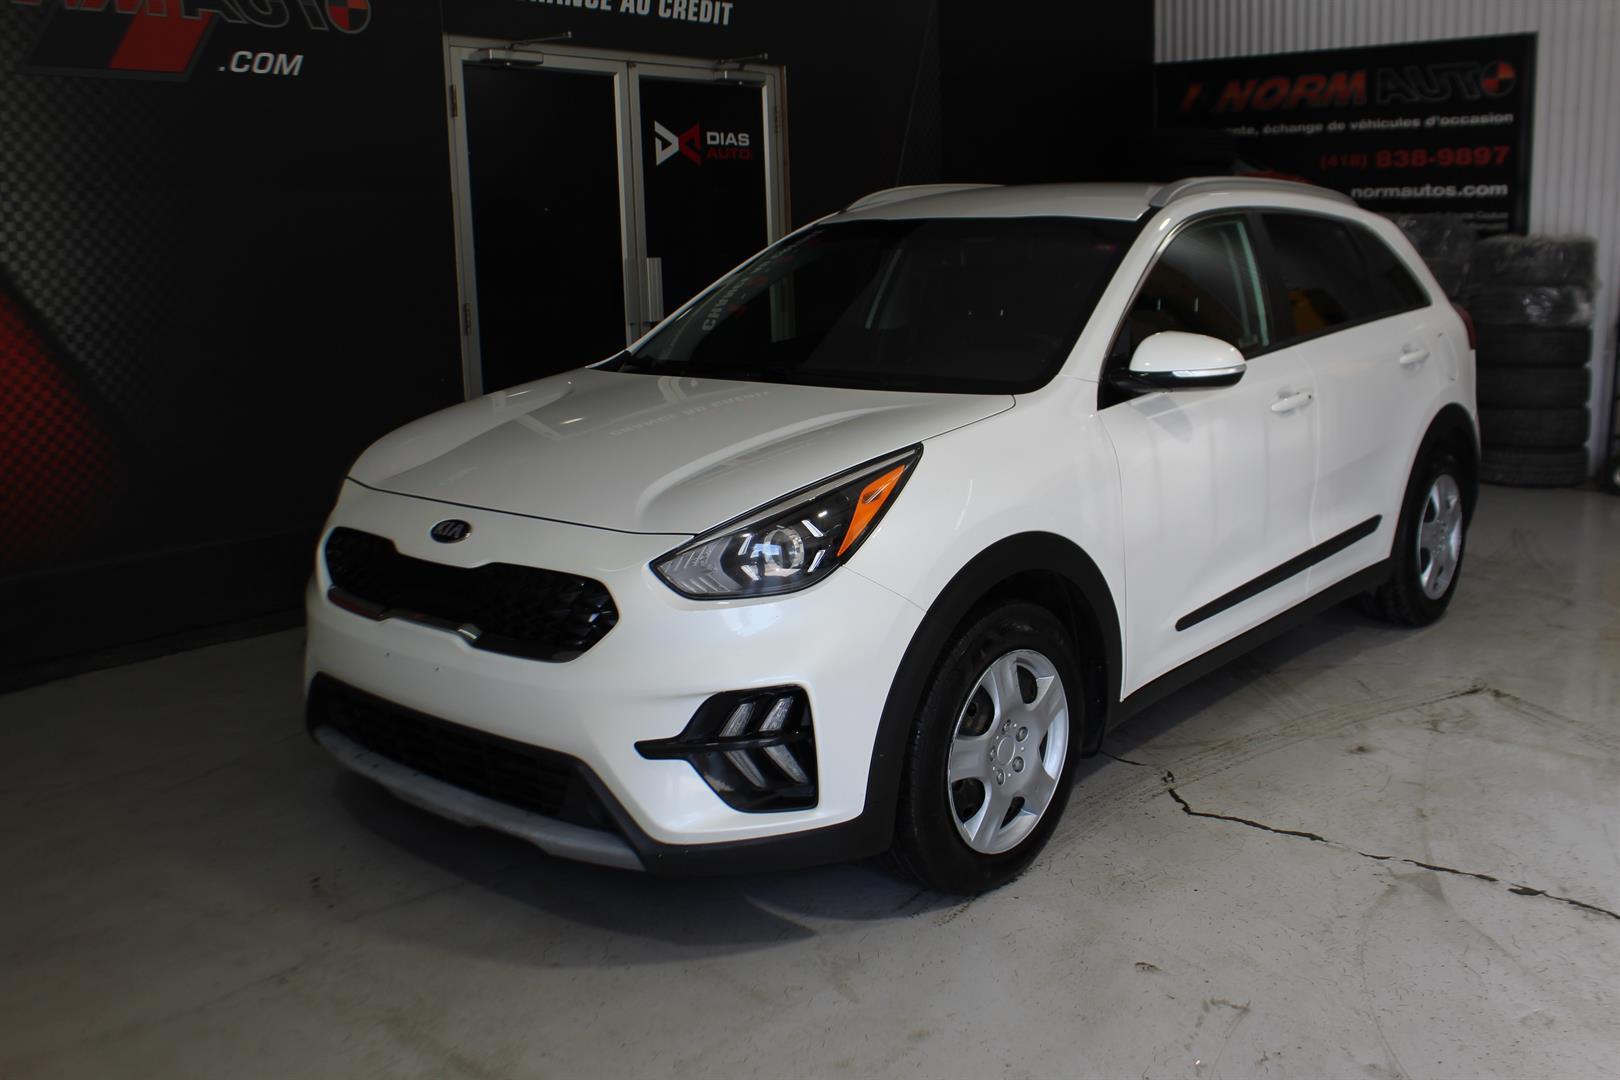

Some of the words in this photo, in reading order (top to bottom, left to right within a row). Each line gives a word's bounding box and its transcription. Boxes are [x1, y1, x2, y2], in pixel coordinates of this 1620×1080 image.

[218, 50, 304, 77] .COM
[1262, 121, 1323, 136] échange
[1326, 120, 1346, 132] de
[1350, 115, 1421, 131] véhicules
[1424, 112, 1513, 127] d'occasion
[706, 131, 751, 146] DIAS
[706, 147, 753, 160] AUTO
[1375, 145, 1510, 169] 838-9897
[1350, 183, 1508, 199] normautos.com
[432, 520, 466, 539] KIA
